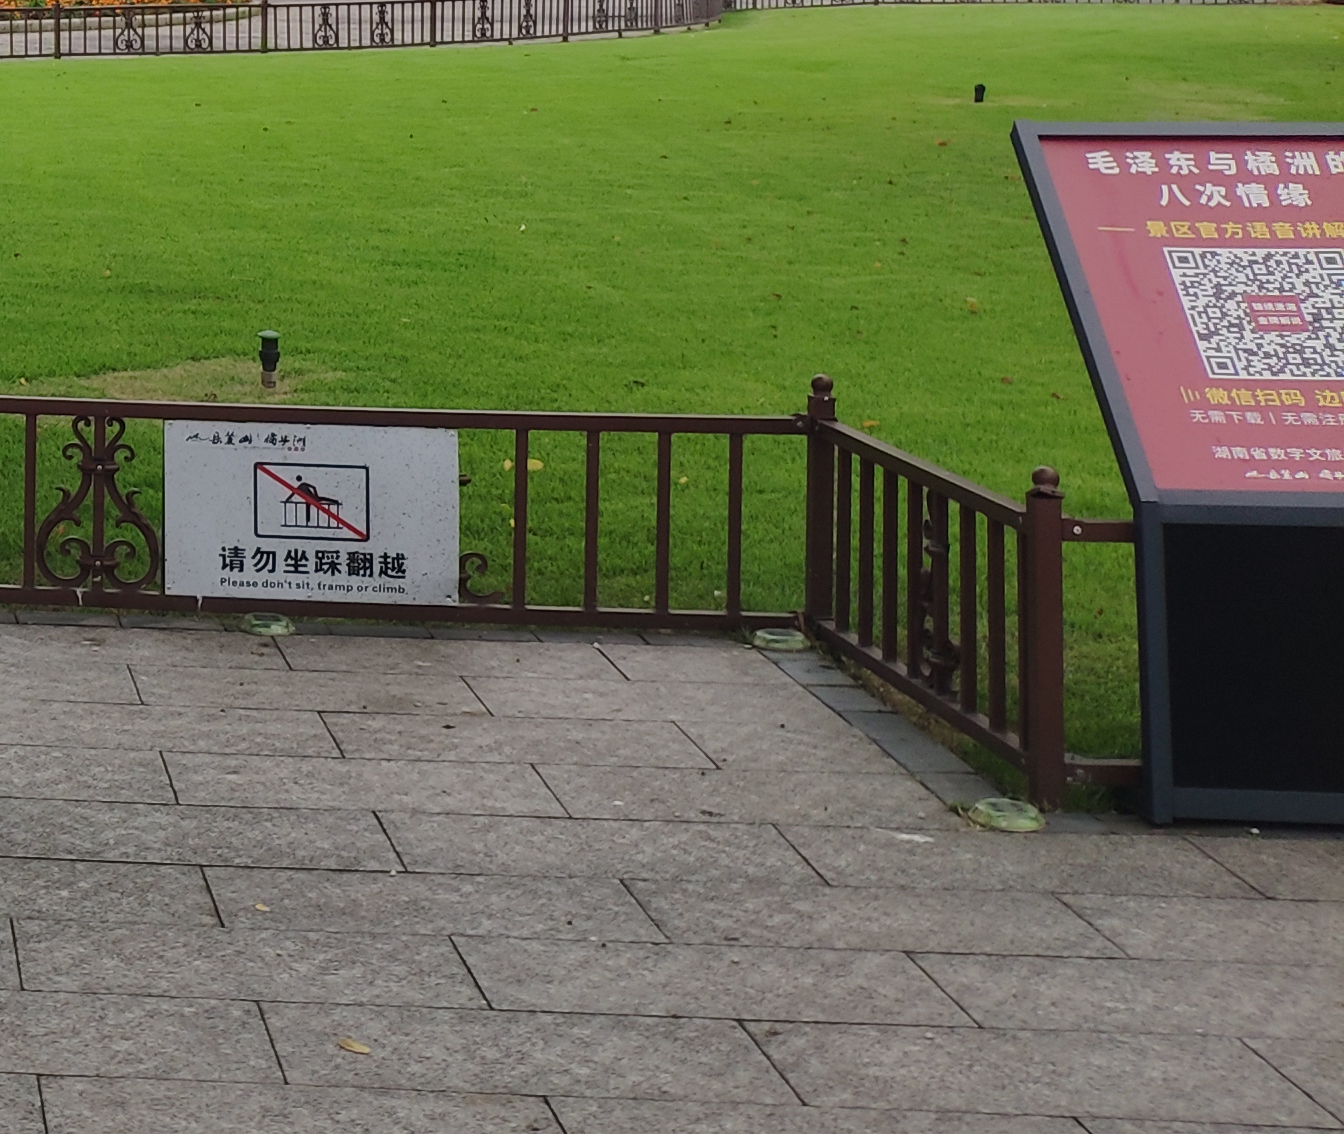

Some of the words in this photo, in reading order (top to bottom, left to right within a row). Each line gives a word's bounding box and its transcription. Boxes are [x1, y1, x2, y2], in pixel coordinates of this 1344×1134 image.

[1159, 182, 1313, 208] 八次情缘
[1204, 387, 1306, 406] 微信扫码
[1314, 389, 1344, 407] 边
[218, 545, 408, 580] 请勿坐踩翻越
[219, 577, 258, 588] Please
[261, 579, 292, 589] don't
[295, 580, 314, 591] sit,
[357, 584, 369, 593] or
